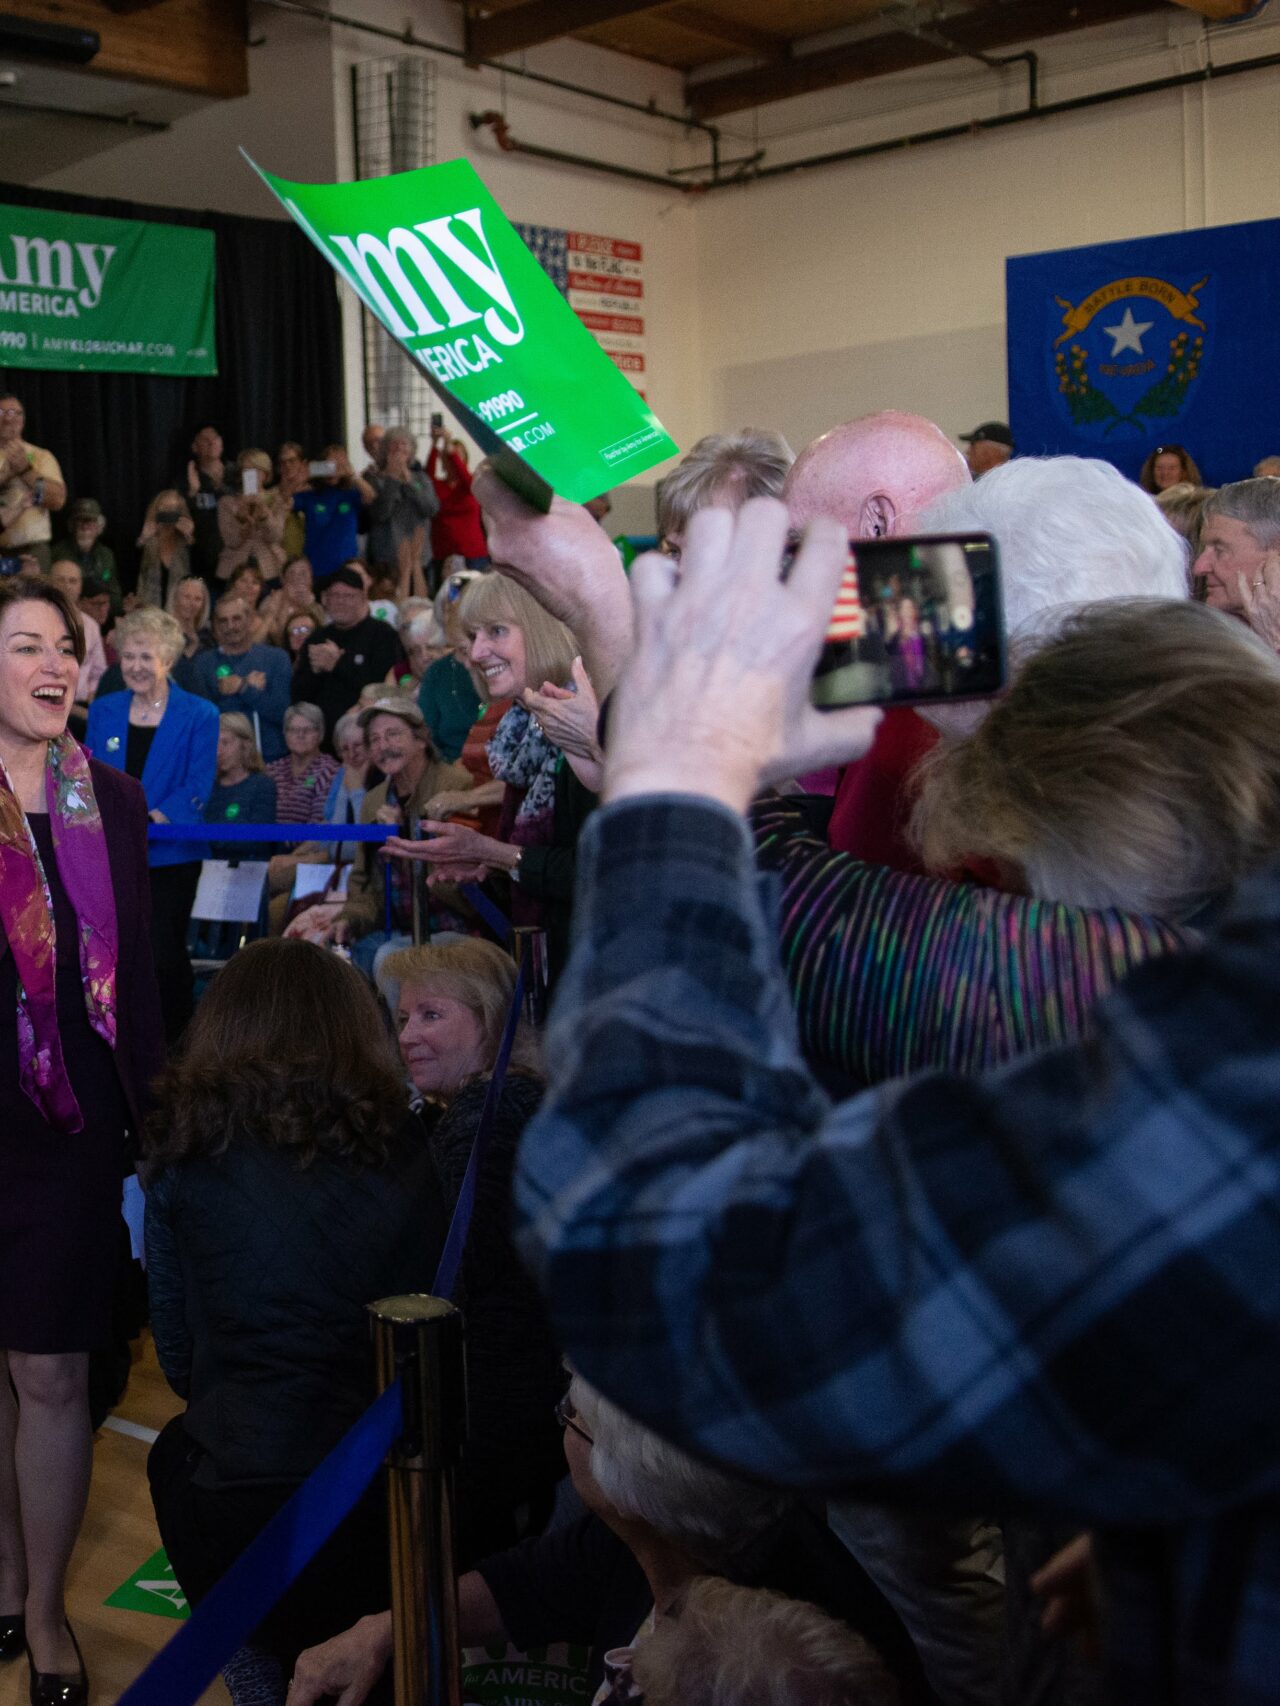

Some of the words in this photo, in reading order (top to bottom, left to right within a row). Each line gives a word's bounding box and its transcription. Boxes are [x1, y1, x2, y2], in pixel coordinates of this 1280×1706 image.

[286, 198, 524, 346] my
[1084, 283, 1132, 314] BATTLE
[1140, 281, 1177, 304] BORN
[478, 389, 525, 422] 91990
[481, 1667, 589, 1696] AMERIC
